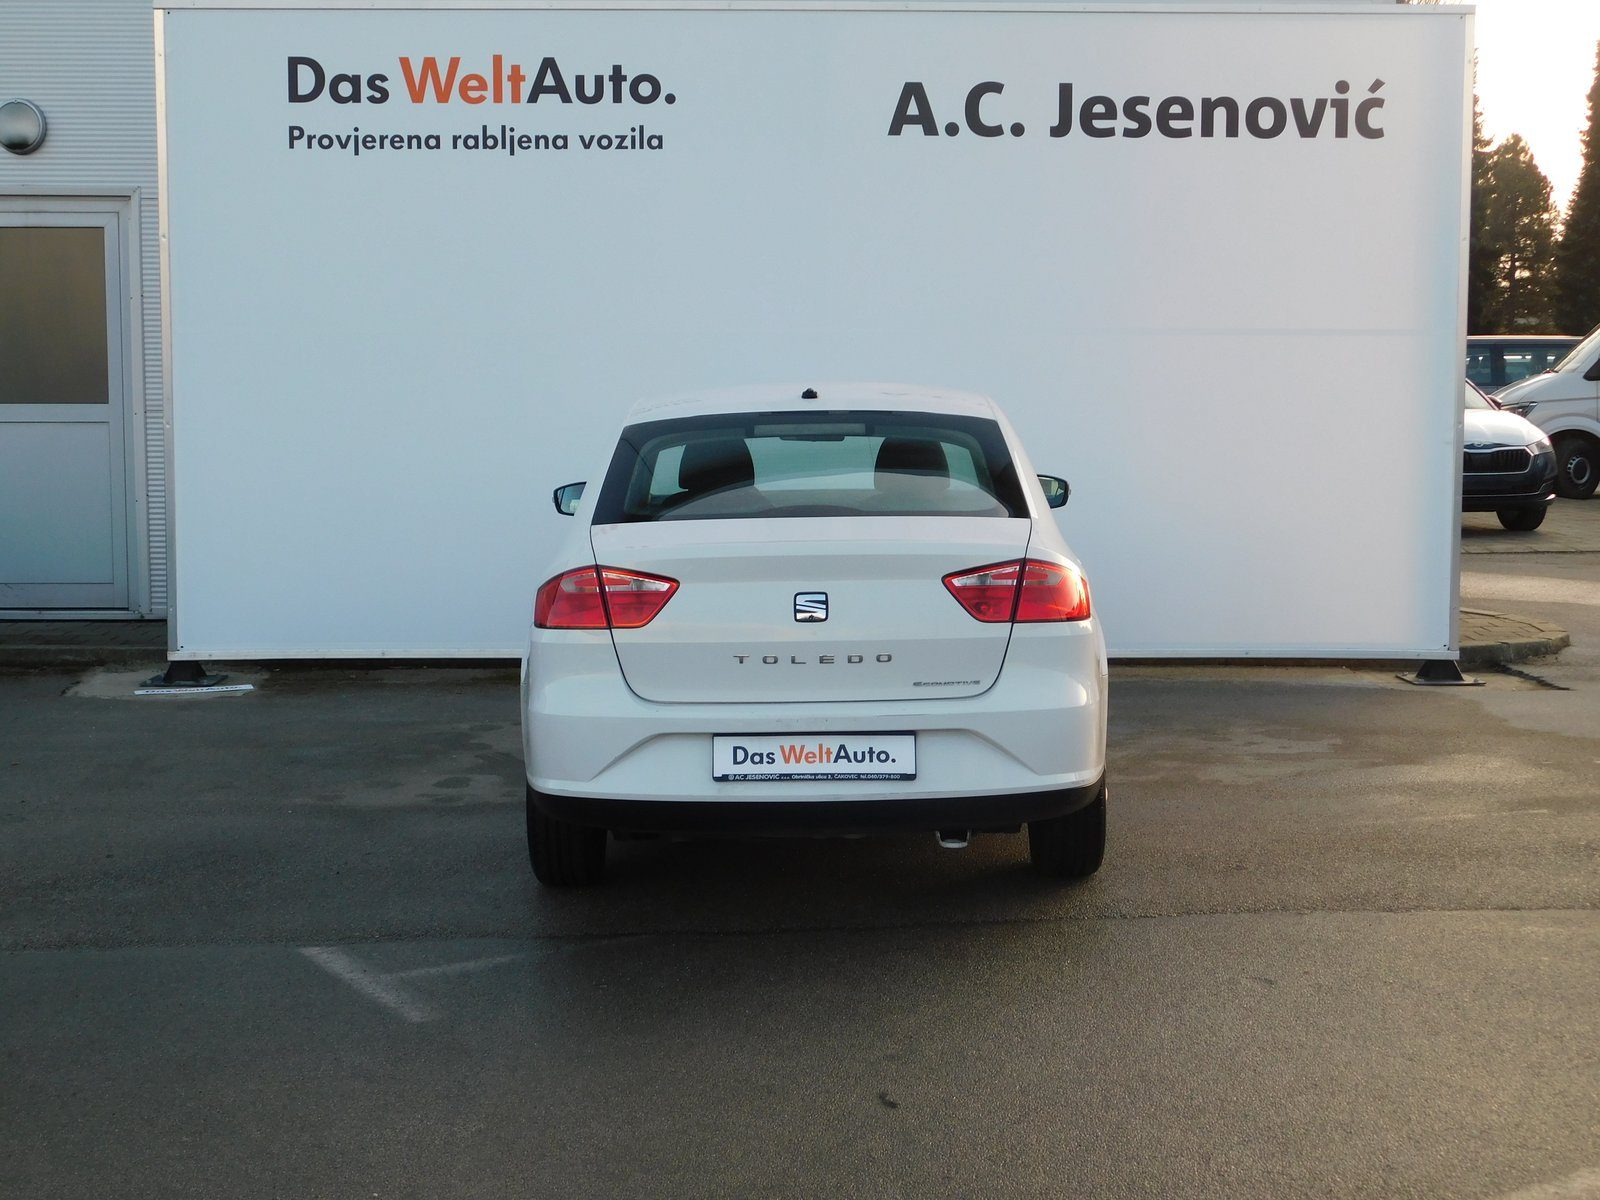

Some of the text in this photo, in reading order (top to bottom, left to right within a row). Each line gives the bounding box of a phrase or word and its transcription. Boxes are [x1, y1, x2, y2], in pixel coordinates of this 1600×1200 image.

[287, 54, 676, 104] Das WeltAuto.
[887, 78, 1386, 139] A.C. Jesenović
[288, 124, 664, 156] Provjerena rabljena vozila
[733, 653, 892, 664] TOLEDO
[732, 743, 896, 764] Das WeltAuto.
